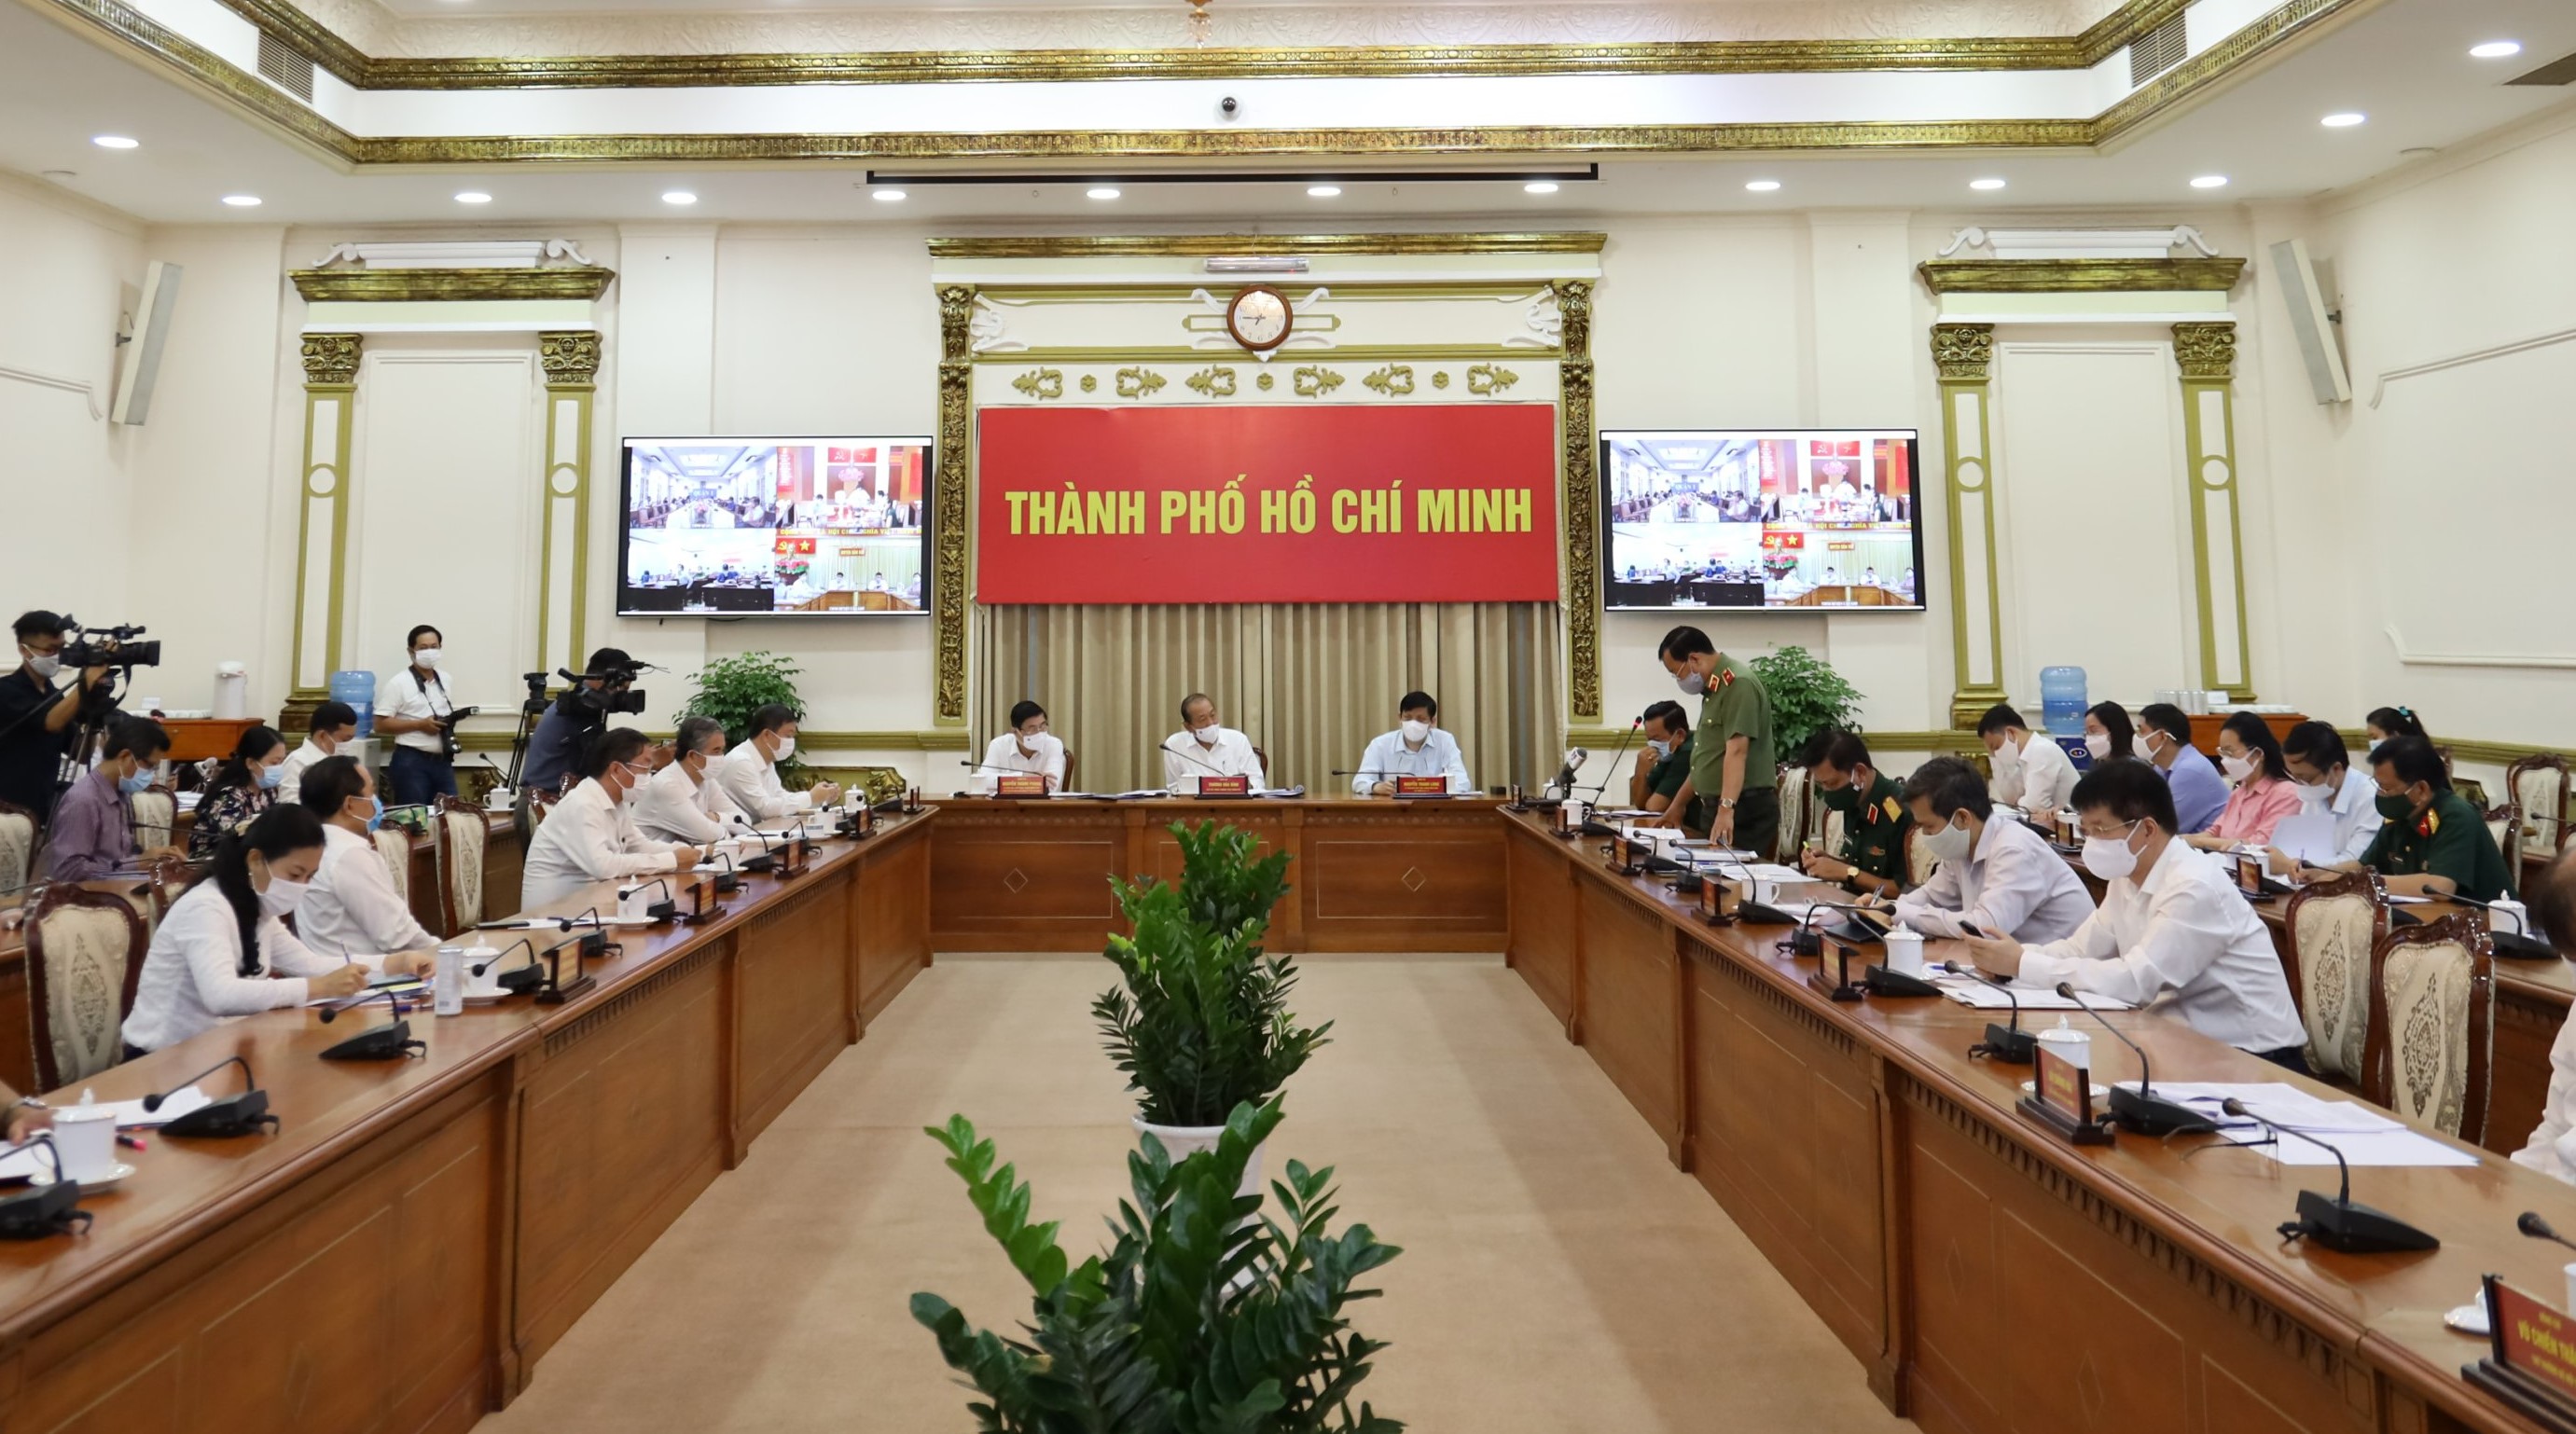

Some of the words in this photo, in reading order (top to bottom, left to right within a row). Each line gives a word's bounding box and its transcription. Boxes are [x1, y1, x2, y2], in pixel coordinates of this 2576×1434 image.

[1004, 481, 1145, 535] THÀNH
[1160, 474, 1248, 535] PHỐ
[1260, 474, 1316, 534] HỒ
[1331, 479, 1403, 534] CHÍ
[1417, 488, 1532, 533] MINH
